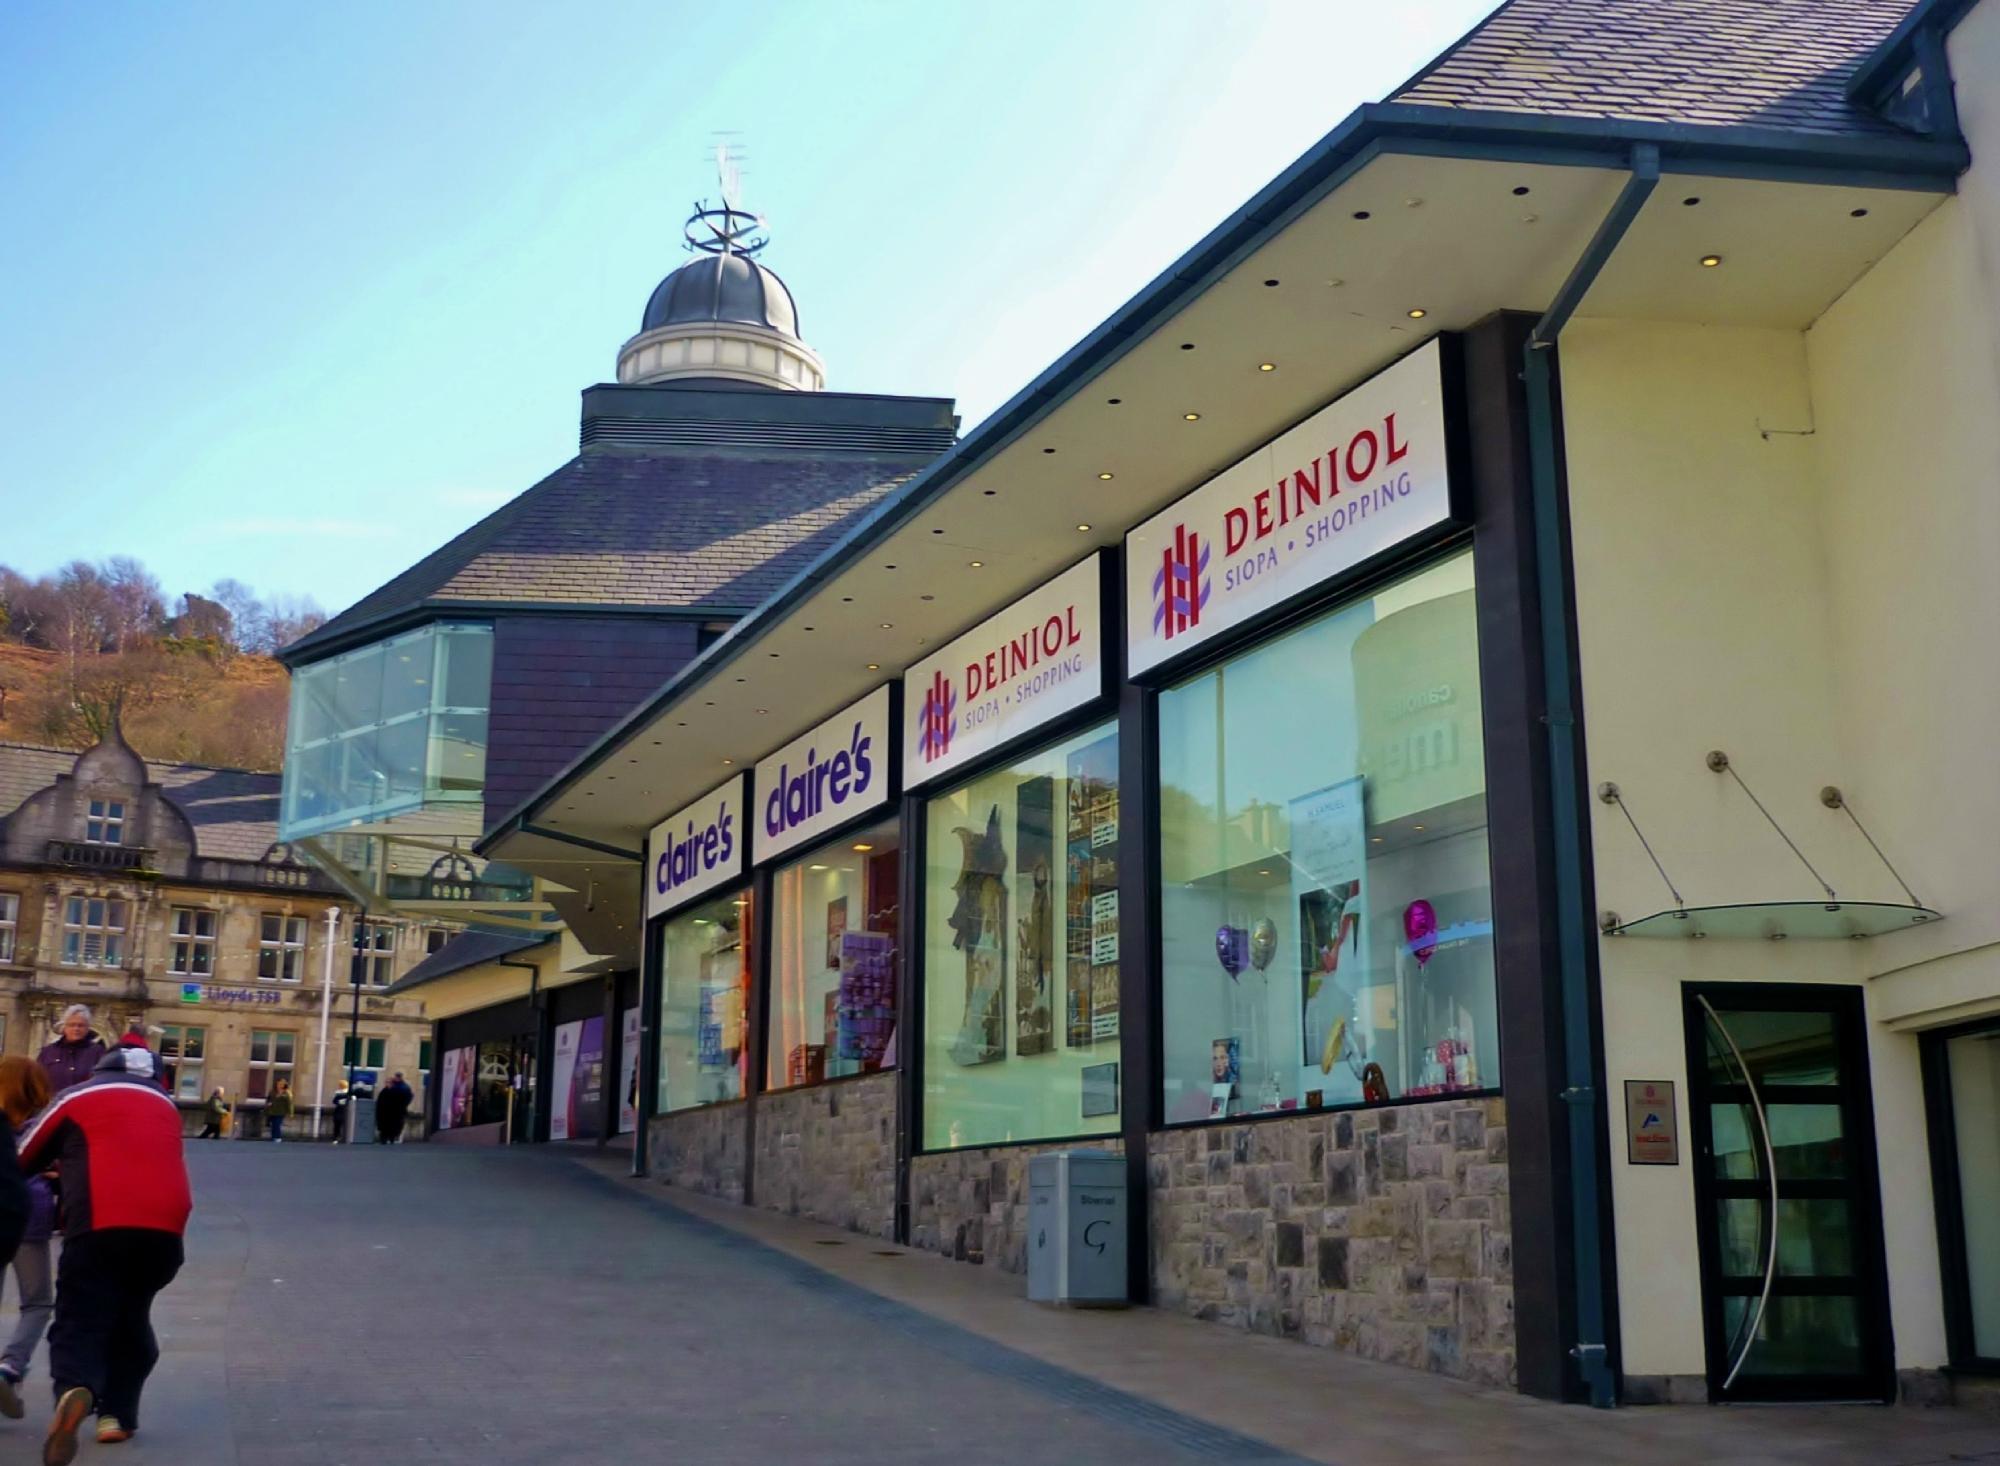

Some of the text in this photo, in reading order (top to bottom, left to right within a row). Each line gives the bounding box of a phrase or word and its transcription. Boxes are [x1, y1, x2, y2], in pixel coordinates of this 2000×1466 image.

[1224, 412, 1409, 558] DEINIOL
[1225, 471, 1412, 592] SIOPA SHOPPING
[965, 605, 1081, 702] DEINIOL
[965, 653, 1082, 730] SIOPA SHOPPING
[766, 720, 871, 838] claire's
[656, 801, 733, 895] claire's
[207, 986, 253, 1005] Lloyds
[256, 990, 281, 1005] TSB
